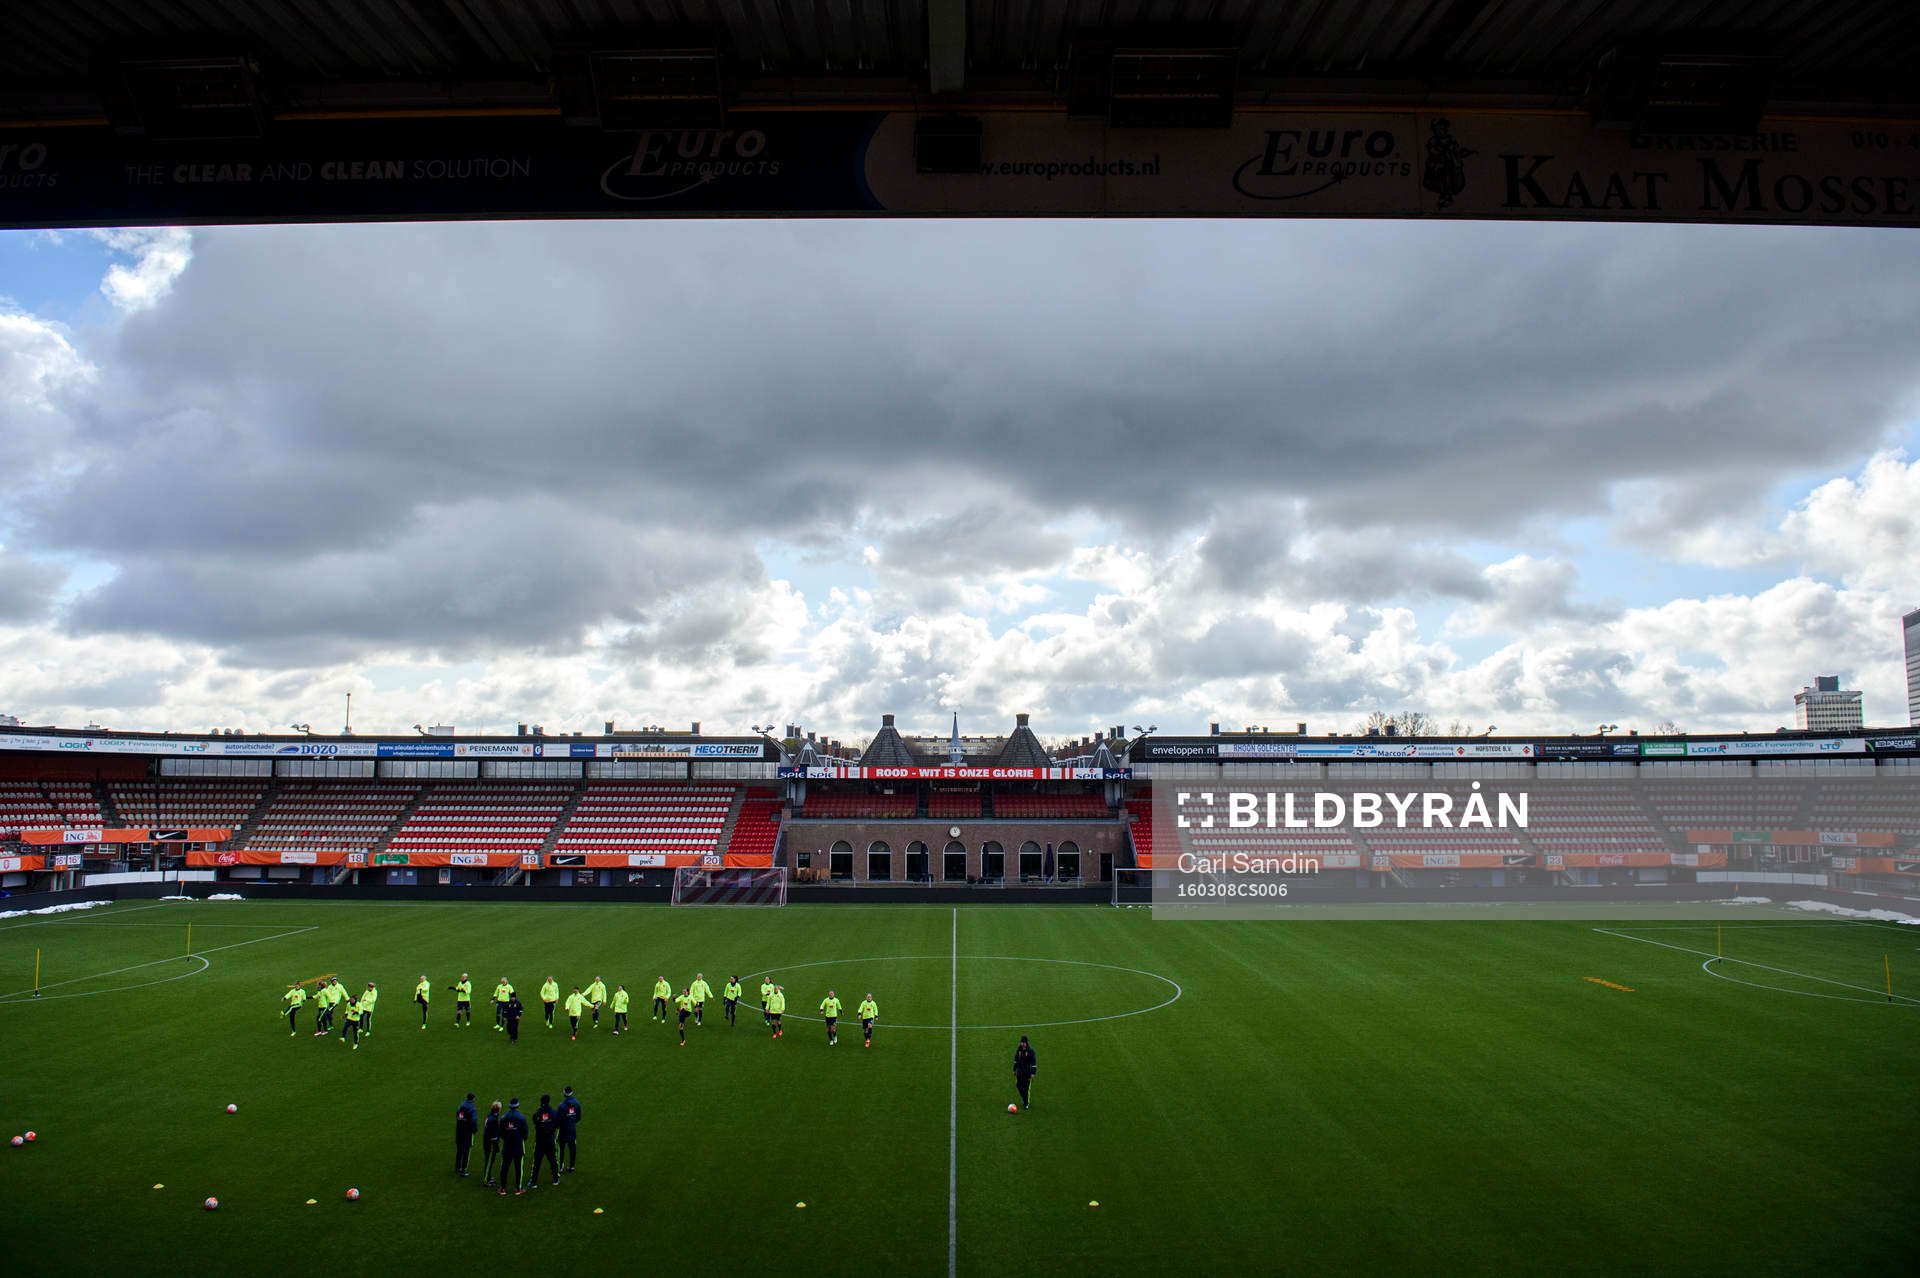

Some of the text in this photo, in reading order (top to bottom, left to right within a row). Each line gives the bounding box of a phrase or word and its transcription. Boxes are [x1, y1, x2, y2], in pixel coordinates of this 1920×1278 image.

[625, 129, 767, 177] Euro
[1258, 130, 1396, 177] Euro
[127, 156, 530, 185] THE CLEAR AND CLEAN SOLUTION
[669, 160, 781, 177] PRODUCTS
[1302, 161, 1411, 177] PRODUCTS
[1499, 154, 1920, 214] KAAT MOSSE
[301, 744, 339, 755] DOZO
[469, 745, 519, 753] PEINEMANN
[695, 745, 759, 754] HECOTHERM
[1152, 745, 1216, 756] enveloppen.nl
[876, 769, 909, 777] ROOD
[918, 769, 941, 777] WIT
[943, 769, 956, 777] IS
[958, 769, 990, 777] ONZE
[993, 769, 1034, 778] GLORIE
[65, 831, 84, 841] ING
[1821, 834, 1841, 843] ING
[351, 854, 362, 862] 18
[452, 856, 472, 864] ING
[525, 855, 536, 863] 19
[706, 856, 718, 865] 20
[1375, 857, 1387, 865] 22
[1425, 857, 1445, 865] ING
[1549, 856, 1561, 865] 23
